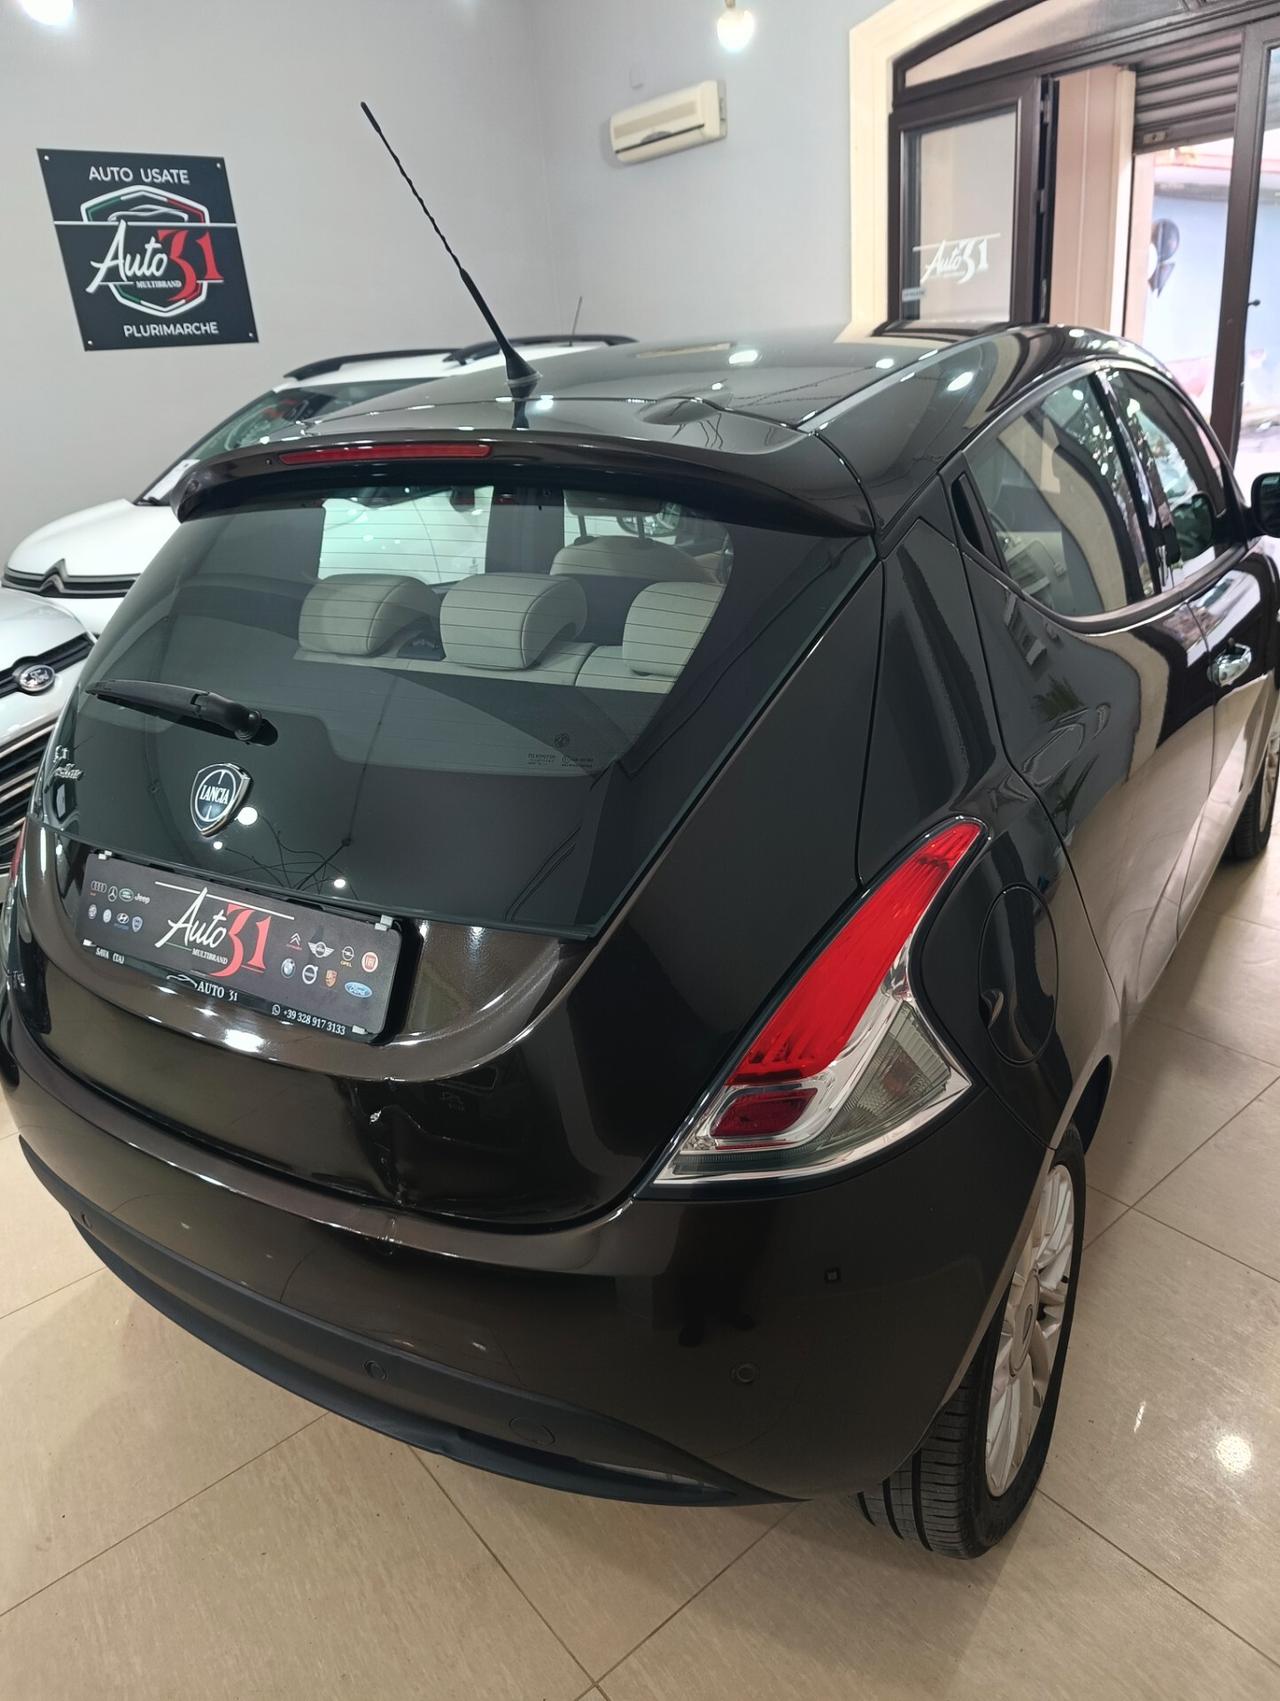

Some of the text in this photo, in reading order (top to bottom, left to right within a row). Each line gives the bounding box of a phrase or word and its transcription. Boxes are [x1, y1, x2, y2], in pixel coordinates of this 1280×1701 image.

[88, 166, 190, 184] AUTO USATE
[136, 280, 182, 289] MULTIBRAND
[123, 321, 219, 337] PLURIMARCHE
[199, 785, 230, 805] LANCIA
[192, 948, 228, 965] MULTIBRAND
[197, 981, 238, 1001] AUTO 31
[283, 1009, 346, 1035] +39 328 917 3133
